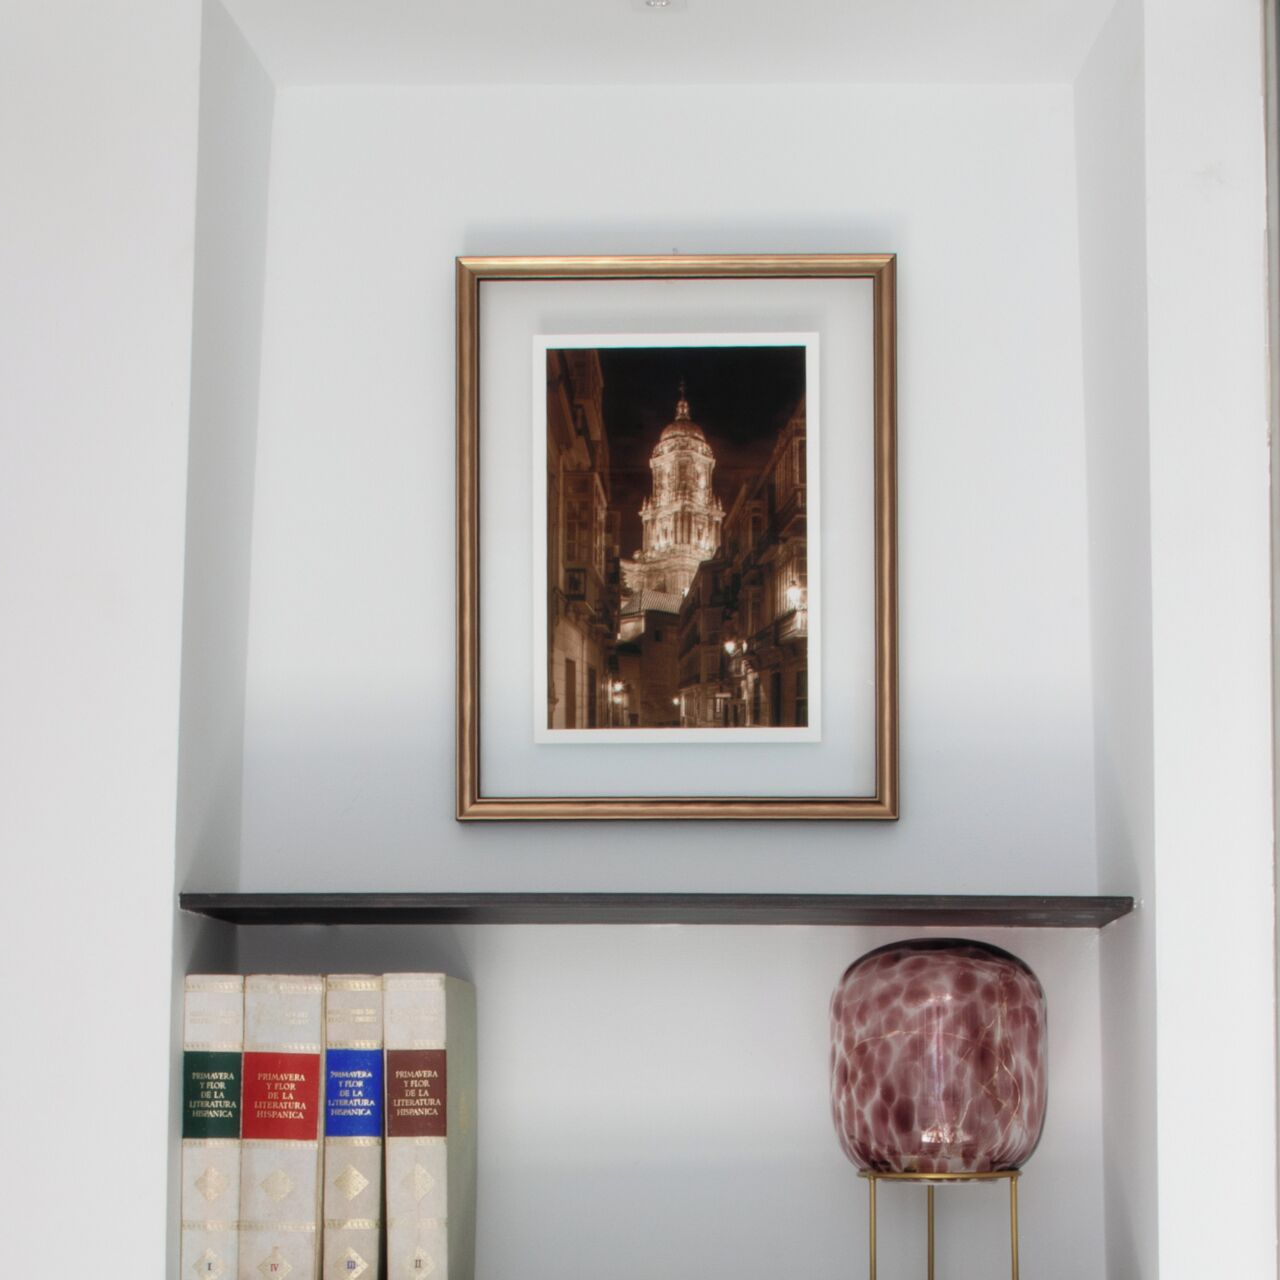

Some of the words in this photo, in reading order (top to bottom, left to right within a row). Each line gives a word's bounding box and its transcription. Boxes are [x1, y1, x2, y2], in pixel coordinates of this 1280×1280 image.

[192, 1072, 234, 1080] PRIMAVERA
[258, 1073, 306, 1081] PRIMAVERA
[395, 1070, 438, 1078] PRIMAVERA
[207, 1082, 226, 1090] FLOR
[345, 1080, 364, 1088] FLOR
[410, 1080, 430, 1088] FLOR
[201, 1091, 210, 1099] DE
[214, 1091, 224, 1099] LA
[268, 1092, 279, 1100] DE
[282, 1092, 294, 1100] LA
[254, 1101, 306, 1110] LITERATURA
